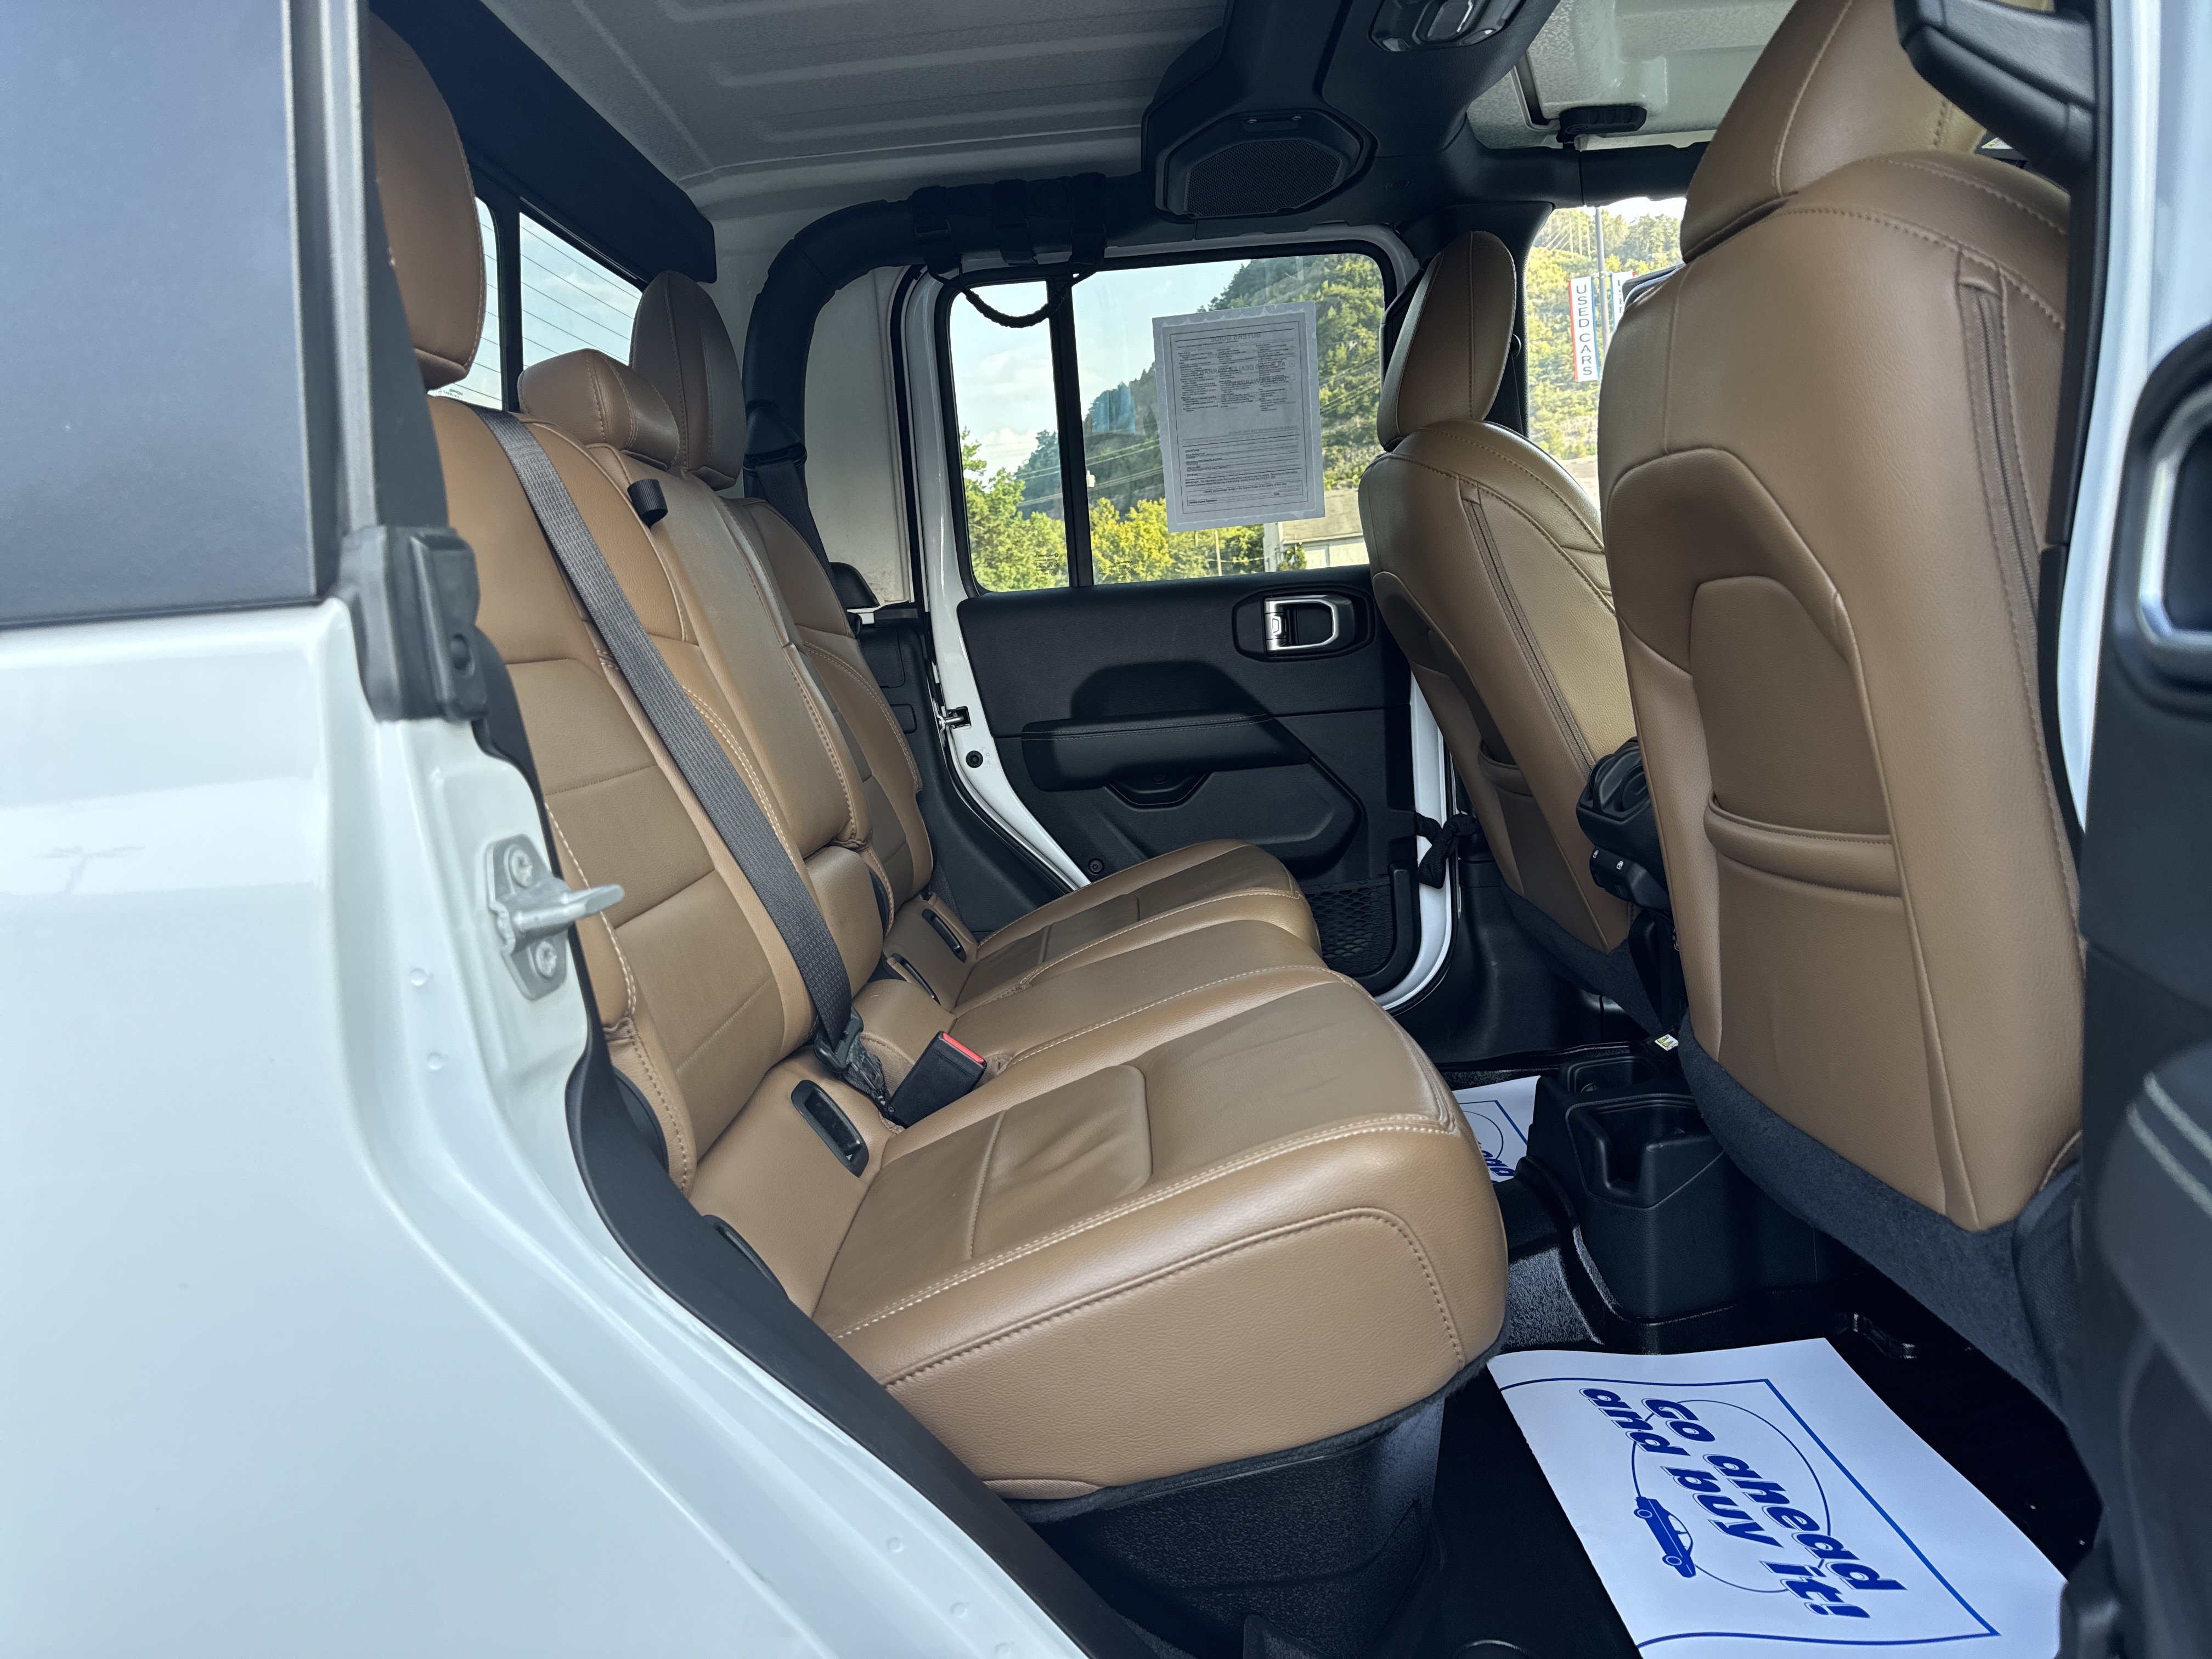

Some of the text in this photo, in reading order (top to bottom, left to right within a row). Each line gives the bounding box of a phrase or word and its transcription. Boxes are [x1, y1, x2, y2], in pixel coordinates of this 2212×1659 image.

[1576, 284, 1593, 376] USED CARS
[1579, 1387, 1871, 1618] and buy it!
[1641, 1398, 1908, 1590] Go ahead
